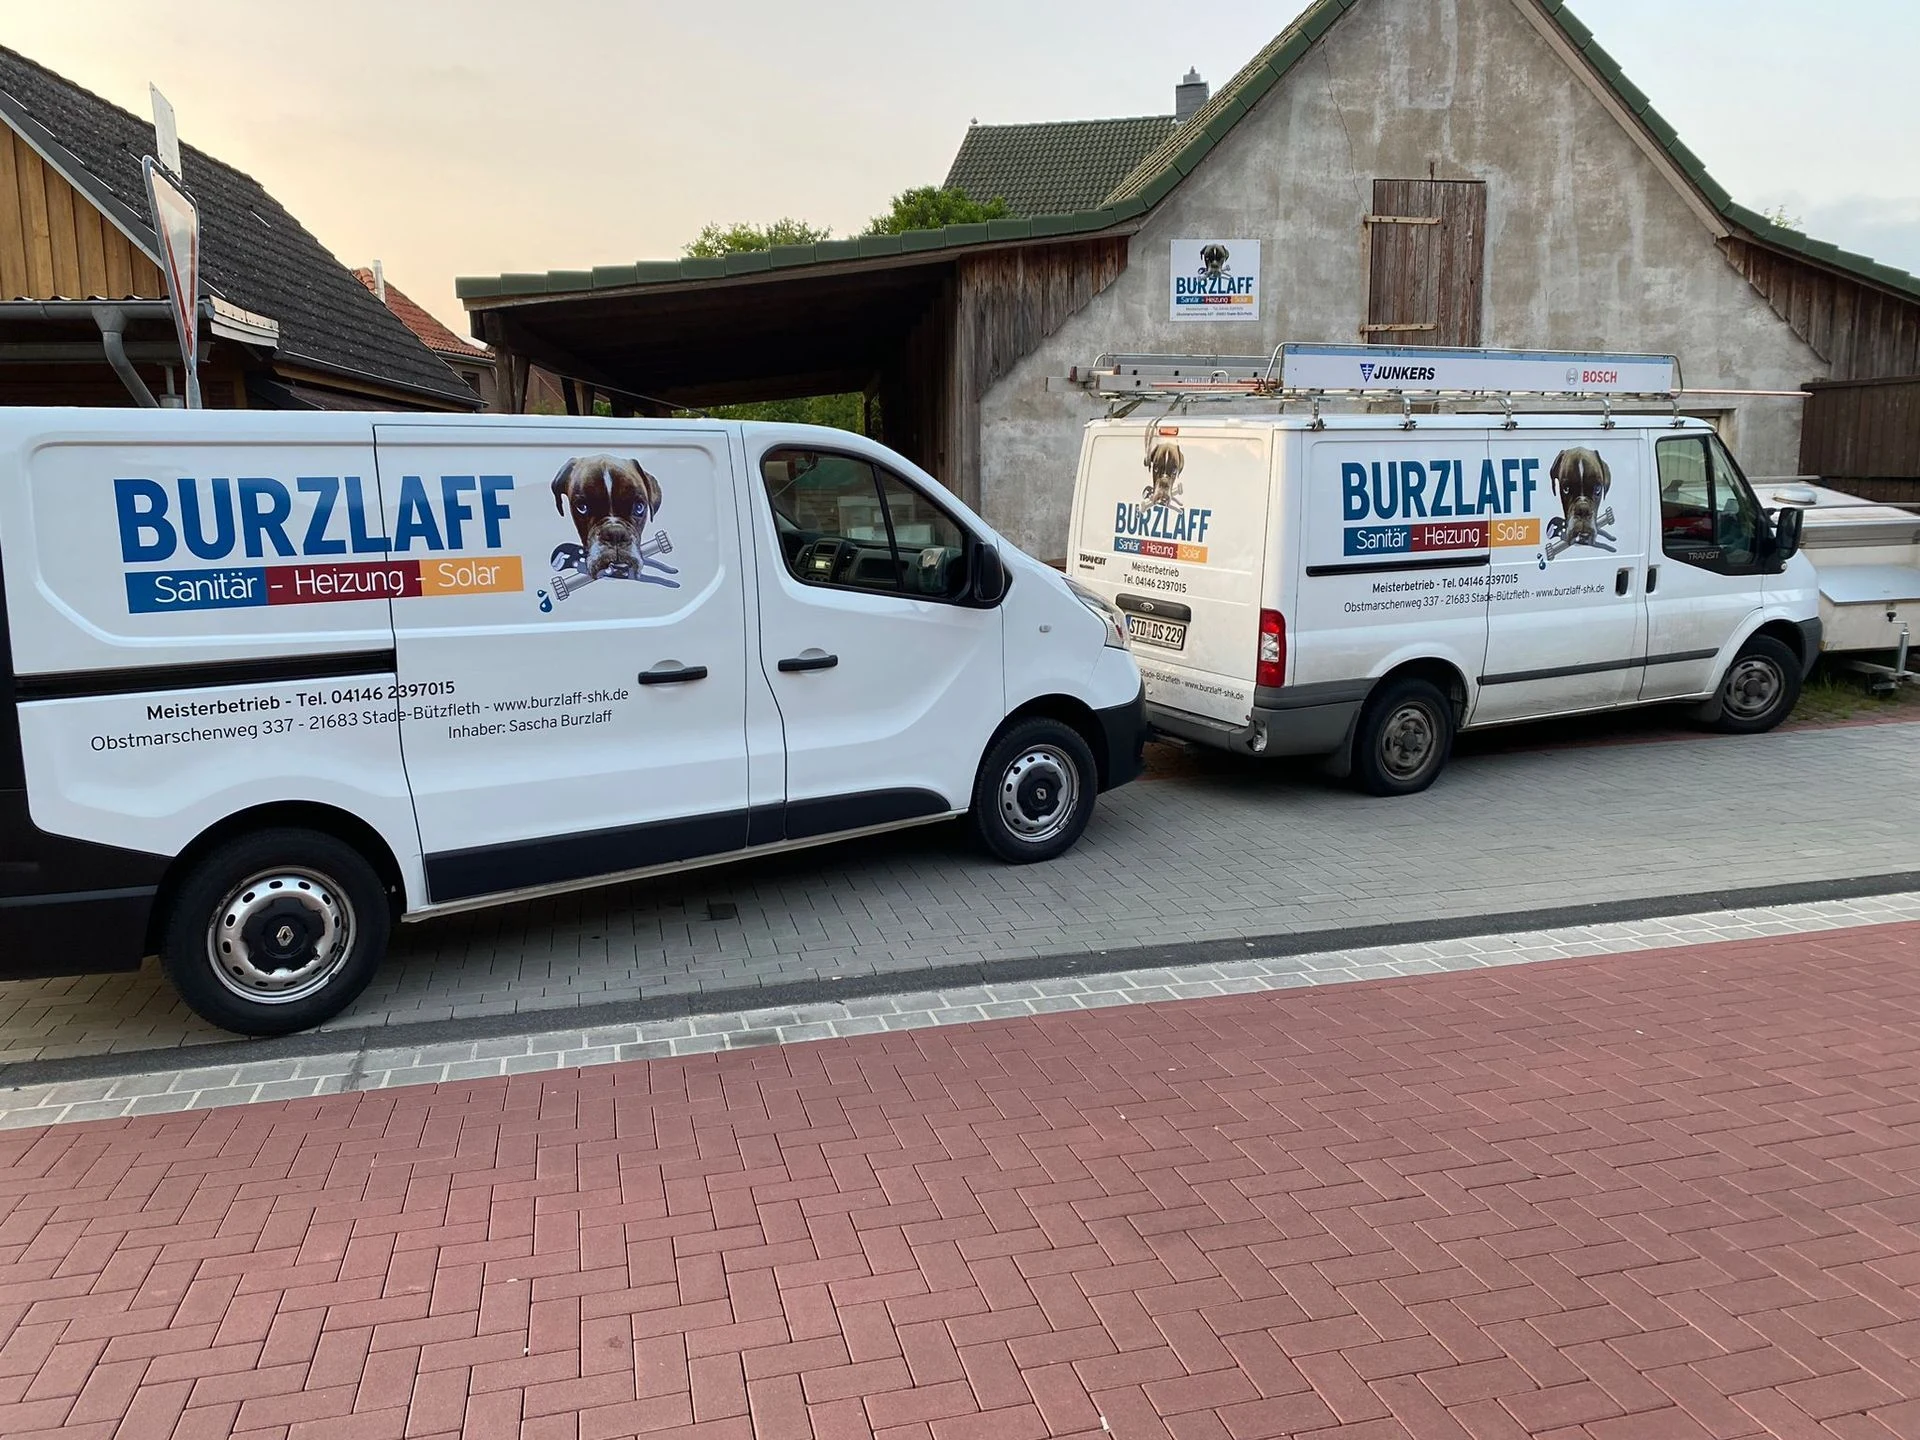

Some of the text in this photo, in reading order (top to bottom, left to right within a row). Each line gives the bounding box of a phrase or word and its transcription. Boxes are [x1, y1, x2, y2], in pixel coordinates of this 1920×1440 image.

[1176, 277, 1254, 294] BURZLAFF
[1374, 366, 1435, 380] JUNKERS
[1582, 370, 1617, 383] BOSCH
[1341, 458, 1539, 521] BURZLAFF
[114, 475, 515, 563] BURZLAFF
[1115, 502, 1212, 542] BURZLAFF
[1118, 538, 1140, 551] Sanitär
[1146, 542, 1174, 557] Heizung
[1356, 529, 1407, 550] Sanitär
[1424, 523, 1480, 547] Heizung
[1496, 522, 1530, 541] Solar
[1688, 551, 1720, 560] TRANSIT
[1132, 561, 1180, 578] Meisterbetrieb
[154, 574, 258, 604] Sanitär
[294, 563, 405, 599] Heizung
[437, 562, 501, 588] Solar
[1124, 574, 1187, 593] Tel. 04146 2397015
[1372, 580, 1435, 593] Meisterbetrieb
[1442, 578, 1457, 588] Tel.
[1458, 577, 1484, 587] 04146
[1485, 574, 1519, 586] 2397015
[1344, 599, 1421, 613] Obstmarschenweg
[1423, 596, 1439, 606] 337
[1445, 594, 1470, 605] 21683
[1471, 590, 1530, 603] Stade-Bützfleth
[1536, 584, 1605, 598] www.burzlaff-shk.de
[1130, 619, 1183, 644] STD DS 229
[146, 695, 281, 721] Meisterbetrieb
[296, 692, 327, 707] Tel.
[331, 686, 383, 704] 04146
[387, 681, 455, 699] 2397015
[1185, 681, 1244, 701] www.burzlaff-shk.de
[90, 723, 258, 752] Obstmarschenweg
[262, 718, 293, 735] 337
[309, 713, 358, 731] 21683
[362, 701, 480, 725] Stade-Bützfleth
[493, 688, 629, 714] www.burzlaff-shk.de
[448, 709, 612, 739] Inhaber: Sascha Burzlaff
